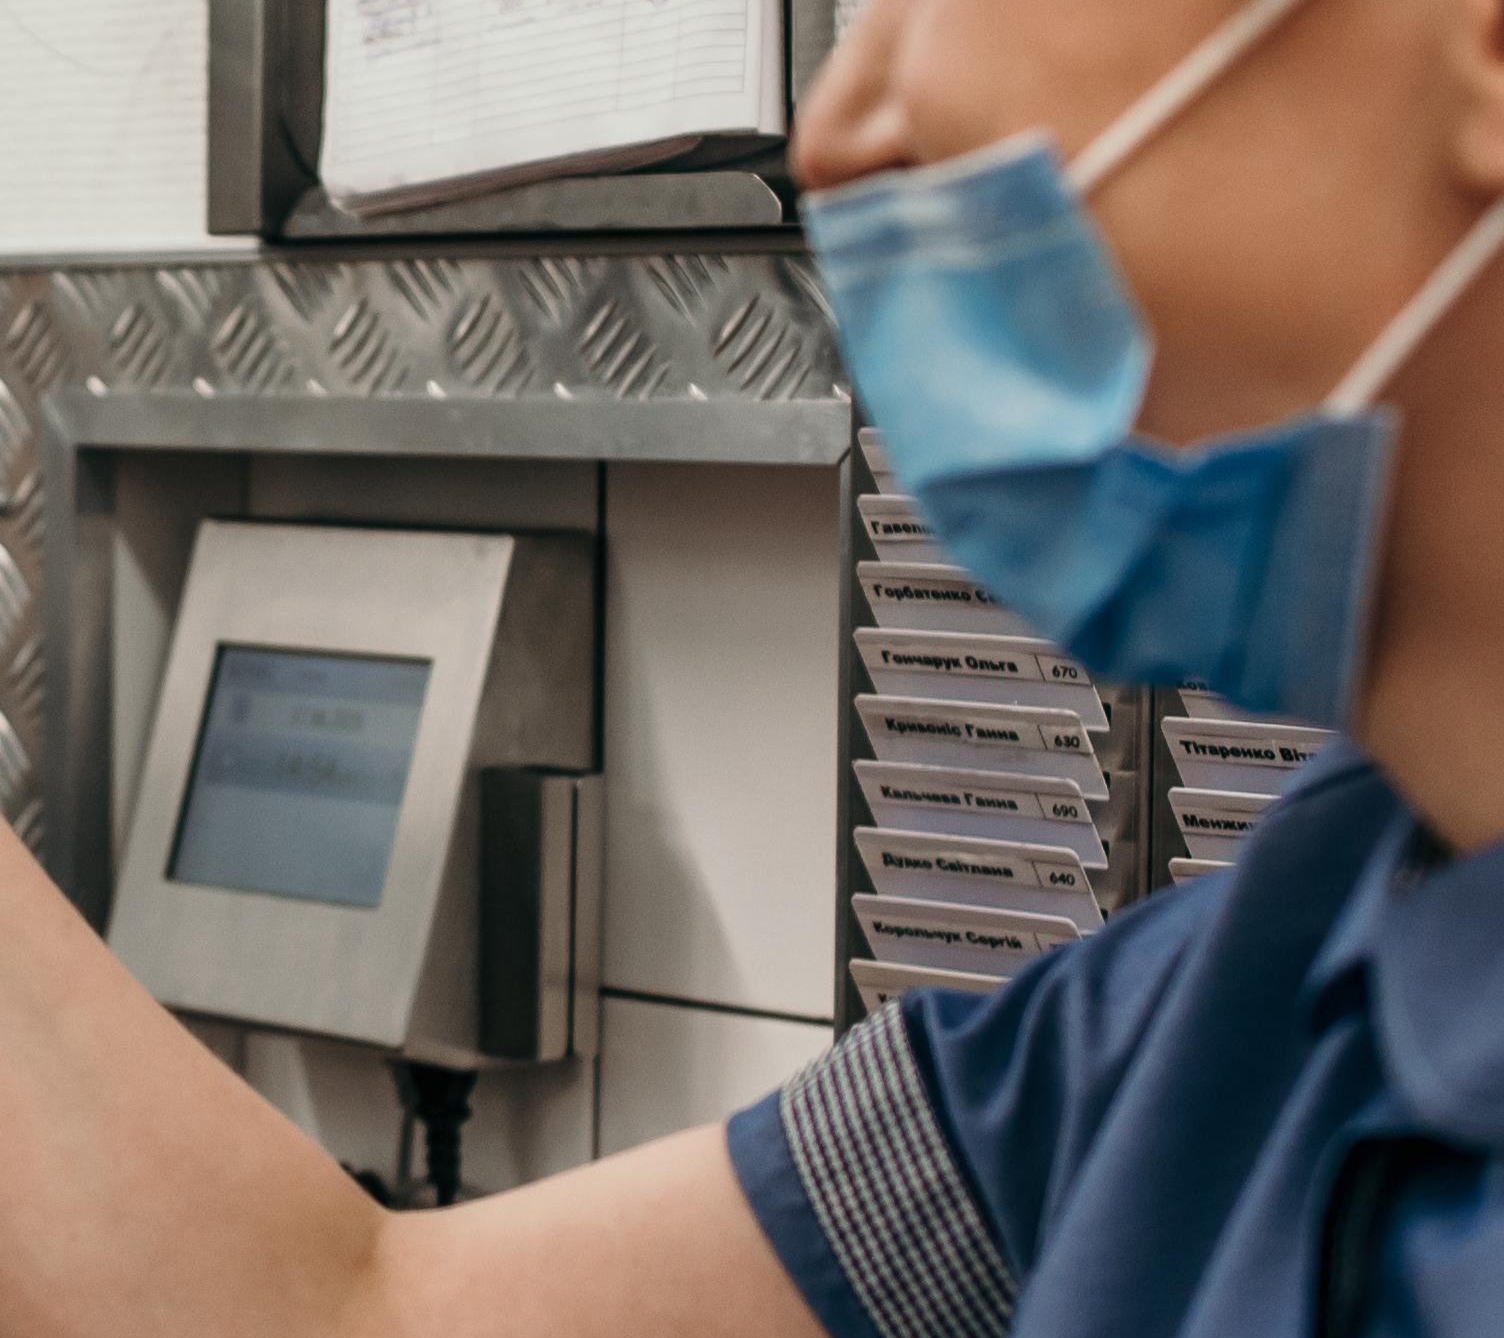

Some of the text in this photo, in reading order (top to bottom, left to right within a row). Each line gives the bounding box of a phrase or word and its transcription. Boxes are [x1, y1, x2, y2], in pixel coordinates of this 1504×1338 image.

[965, 655, 1019, 673] Ольга
[1052, 664, 1078, 679] 670
[964, 723, 1020, 742] Ганна
[1054, 734, 1080, 749] 630
[1179, 740, 1277, 760] Тітаренко
[963, 792, 1019, 811] Ганна
[1052, 804, 1079, 819] 690
[935, 857, 1015, 878] Світлана
[1049, 870, 1076, 886] 640
[965, 930, 1024, 951] Сергій
